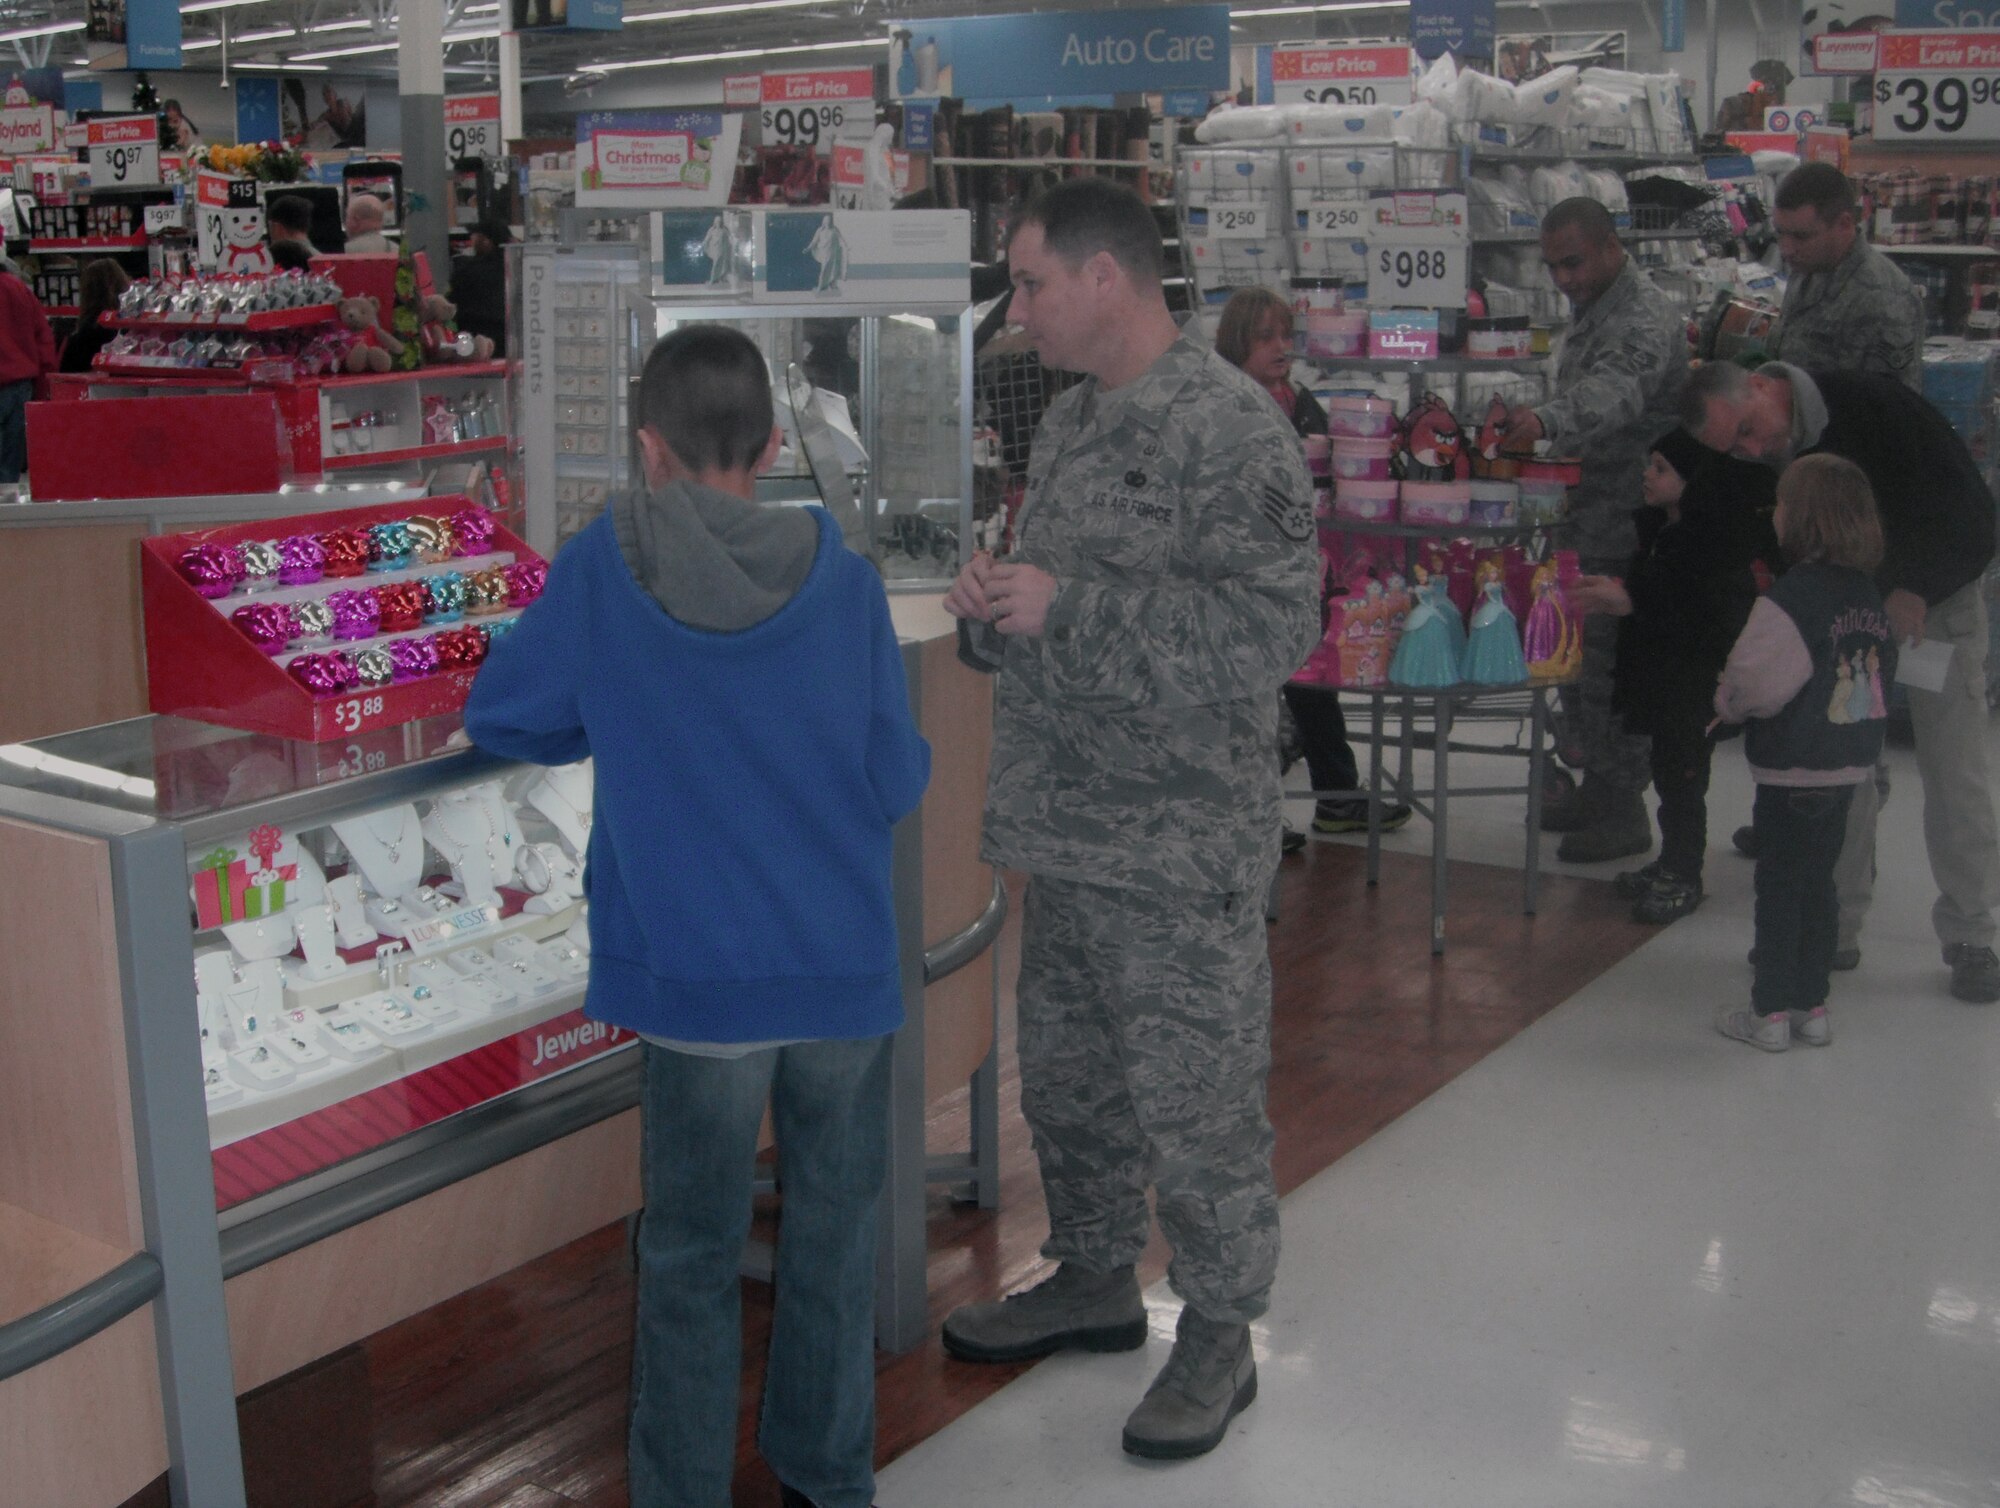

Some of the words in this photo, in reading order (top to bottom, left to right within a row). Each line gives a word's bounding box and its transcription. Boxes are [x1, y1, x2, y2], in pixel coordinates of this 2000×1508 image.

[1061, 32, 1137, 66] Auto
[1143, 29, 1214, 63] Care
[1919, 46, 1963, 65] Low
[1967, 45, 2000, 64] Pri
[1301, 58, 1335, 73] Low
[1336, 57, 1377, 73] Price
[786, 84, 812, 97] Low
[815, 81, 848, 96] Price
[120, 126, 141, 137] Price
[606, 150, 681, 164] Christmas
[232, 184, 254, 198] $15
[1216, 211, 1256, 229] $250
[1316, 210, 1358, 229] $250
[1380, 249, 1446, 288] $988
[529, 265, 545, 394] Pendants
[1110, 496, 1128, 513] AIR
[1130, 499, 1174, 523] FORCE
[335, 695, 383, 732] $388
